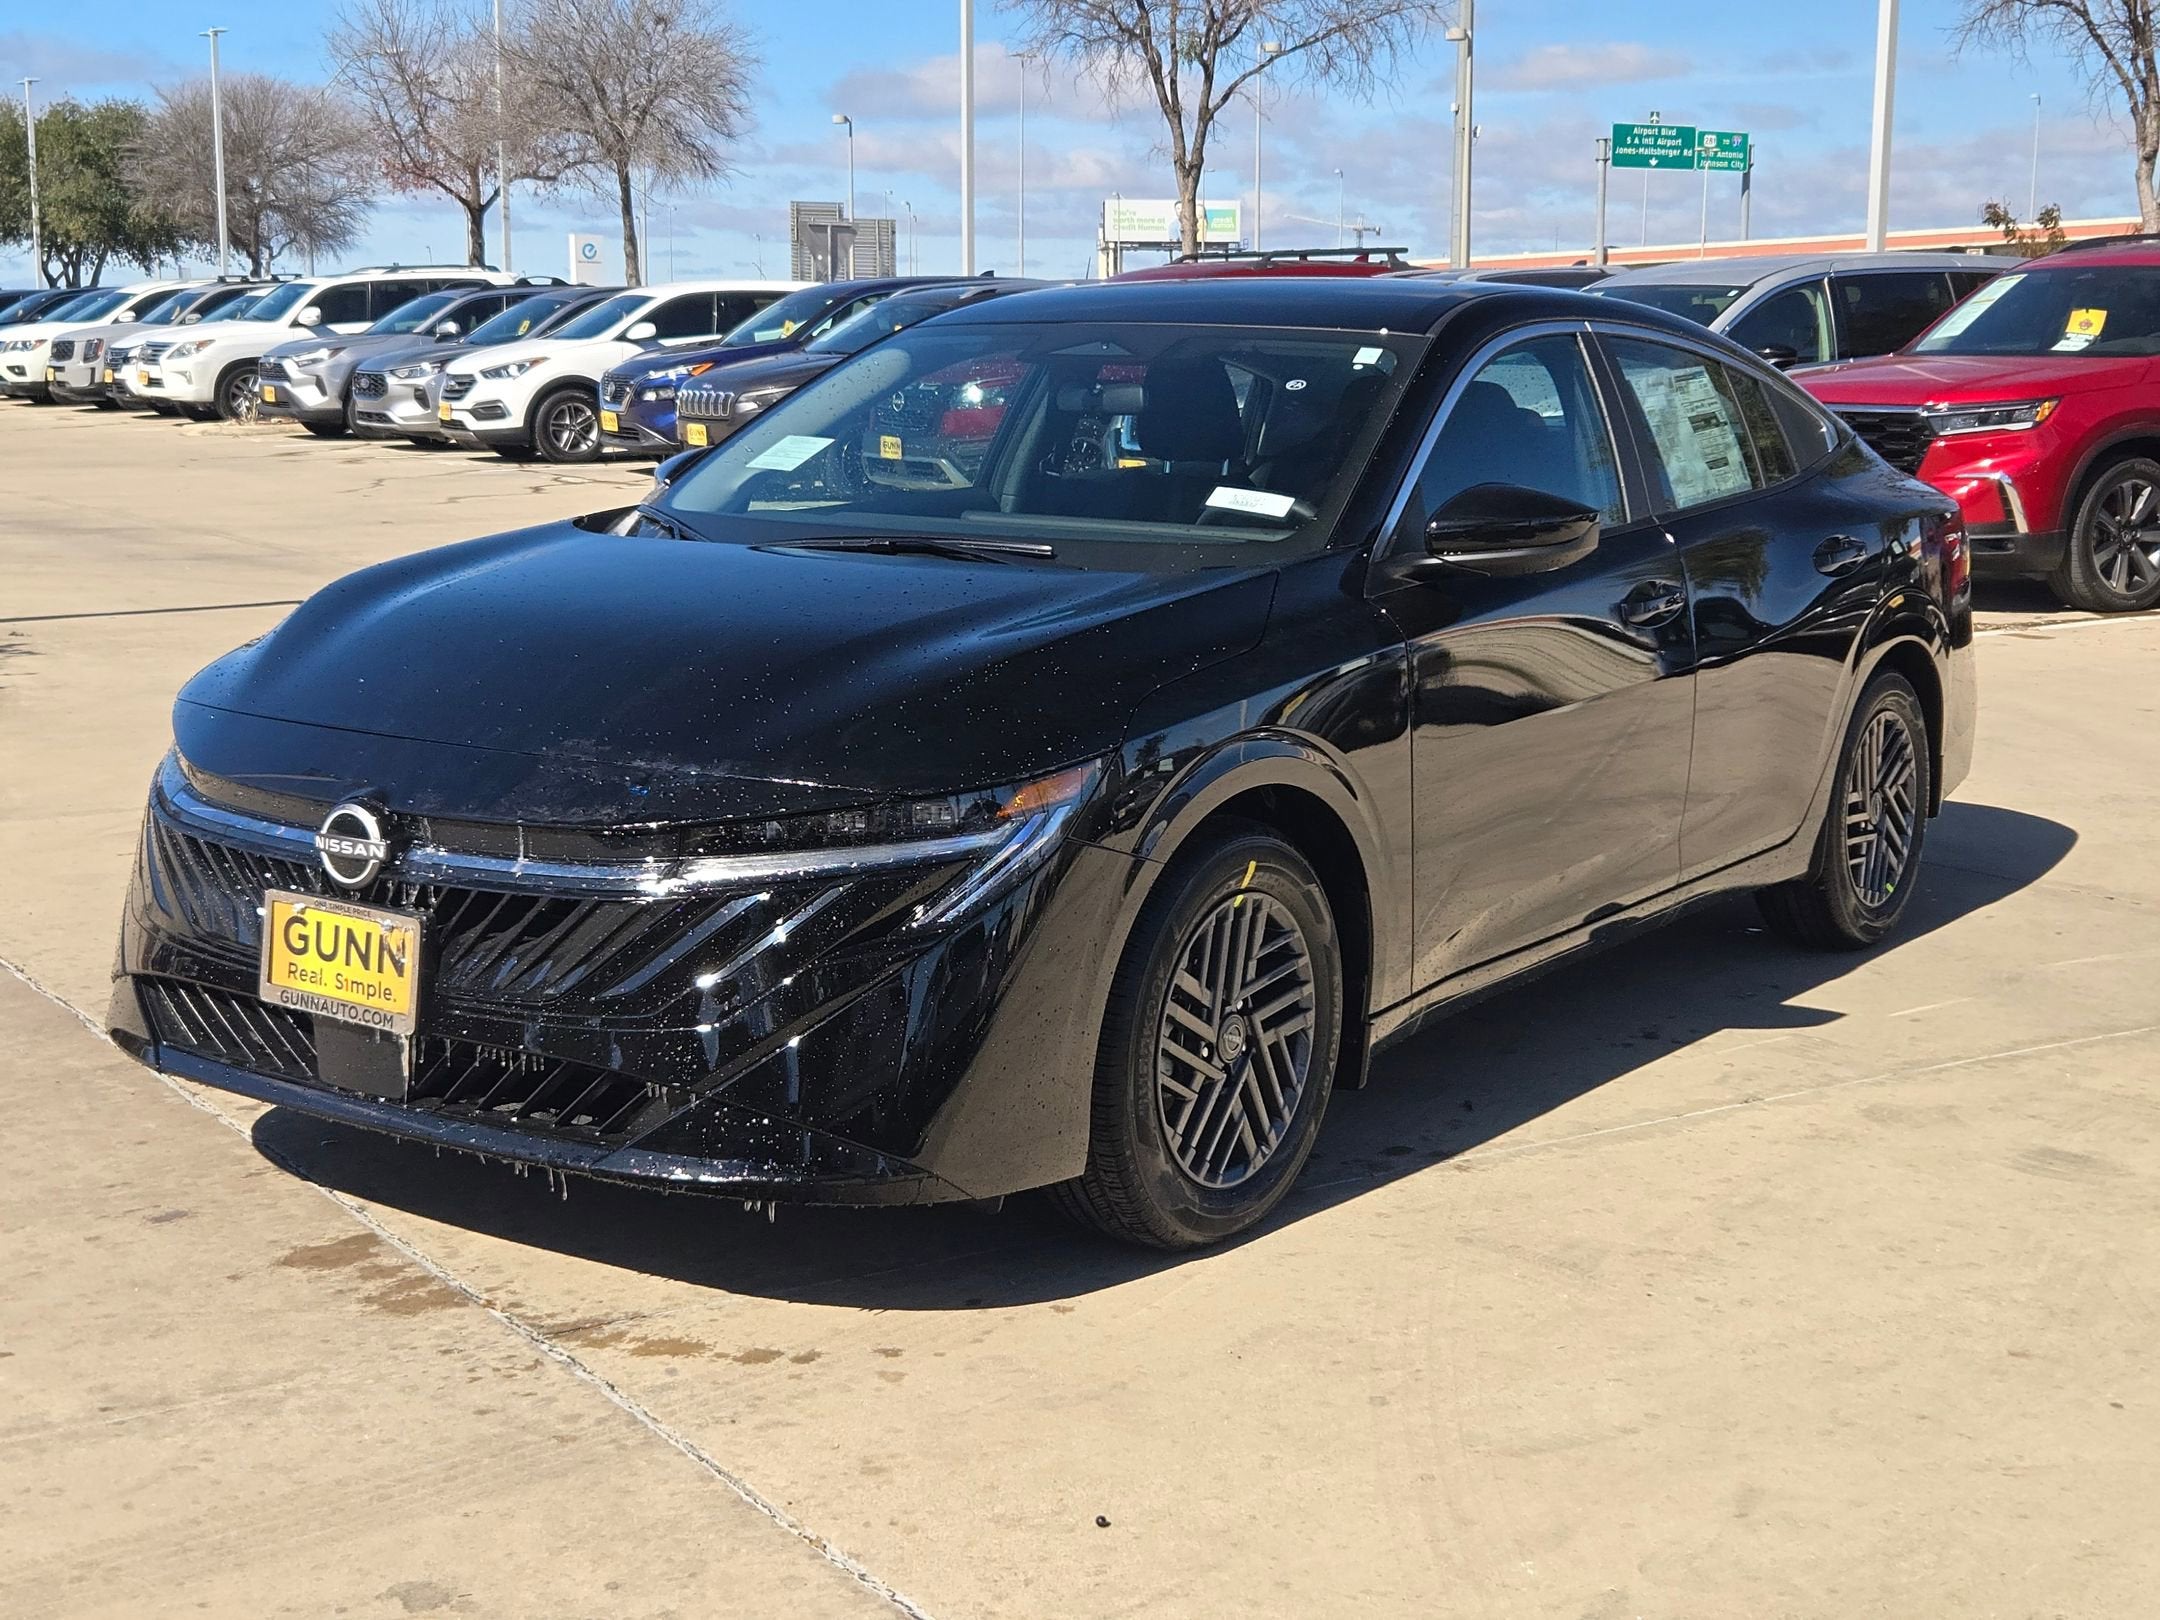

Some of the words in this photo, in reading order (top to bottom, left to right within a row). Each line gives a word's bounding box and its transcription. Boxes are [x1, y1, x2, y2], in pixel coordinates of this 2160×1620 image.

[1633, 127, 1659, 136] Airport
[1661, 128, 1677, 136] Blvd
[1657, 138, 1682, 147] Airport
[1615, 146, 1680, 157] Jones-Maltsberger
[1683, 149, 1693, 157] Rd
[1716, 151, 1744, 159] Antonio
[1731, 161, 1744, 170] City
[315, 836, 385, 858] NISSAN
[283, 915, 406, 977] GUNN
[287, 962, 327, 987] Real.
[280, 990, 393, 1030] GUNNAUTO.COM
